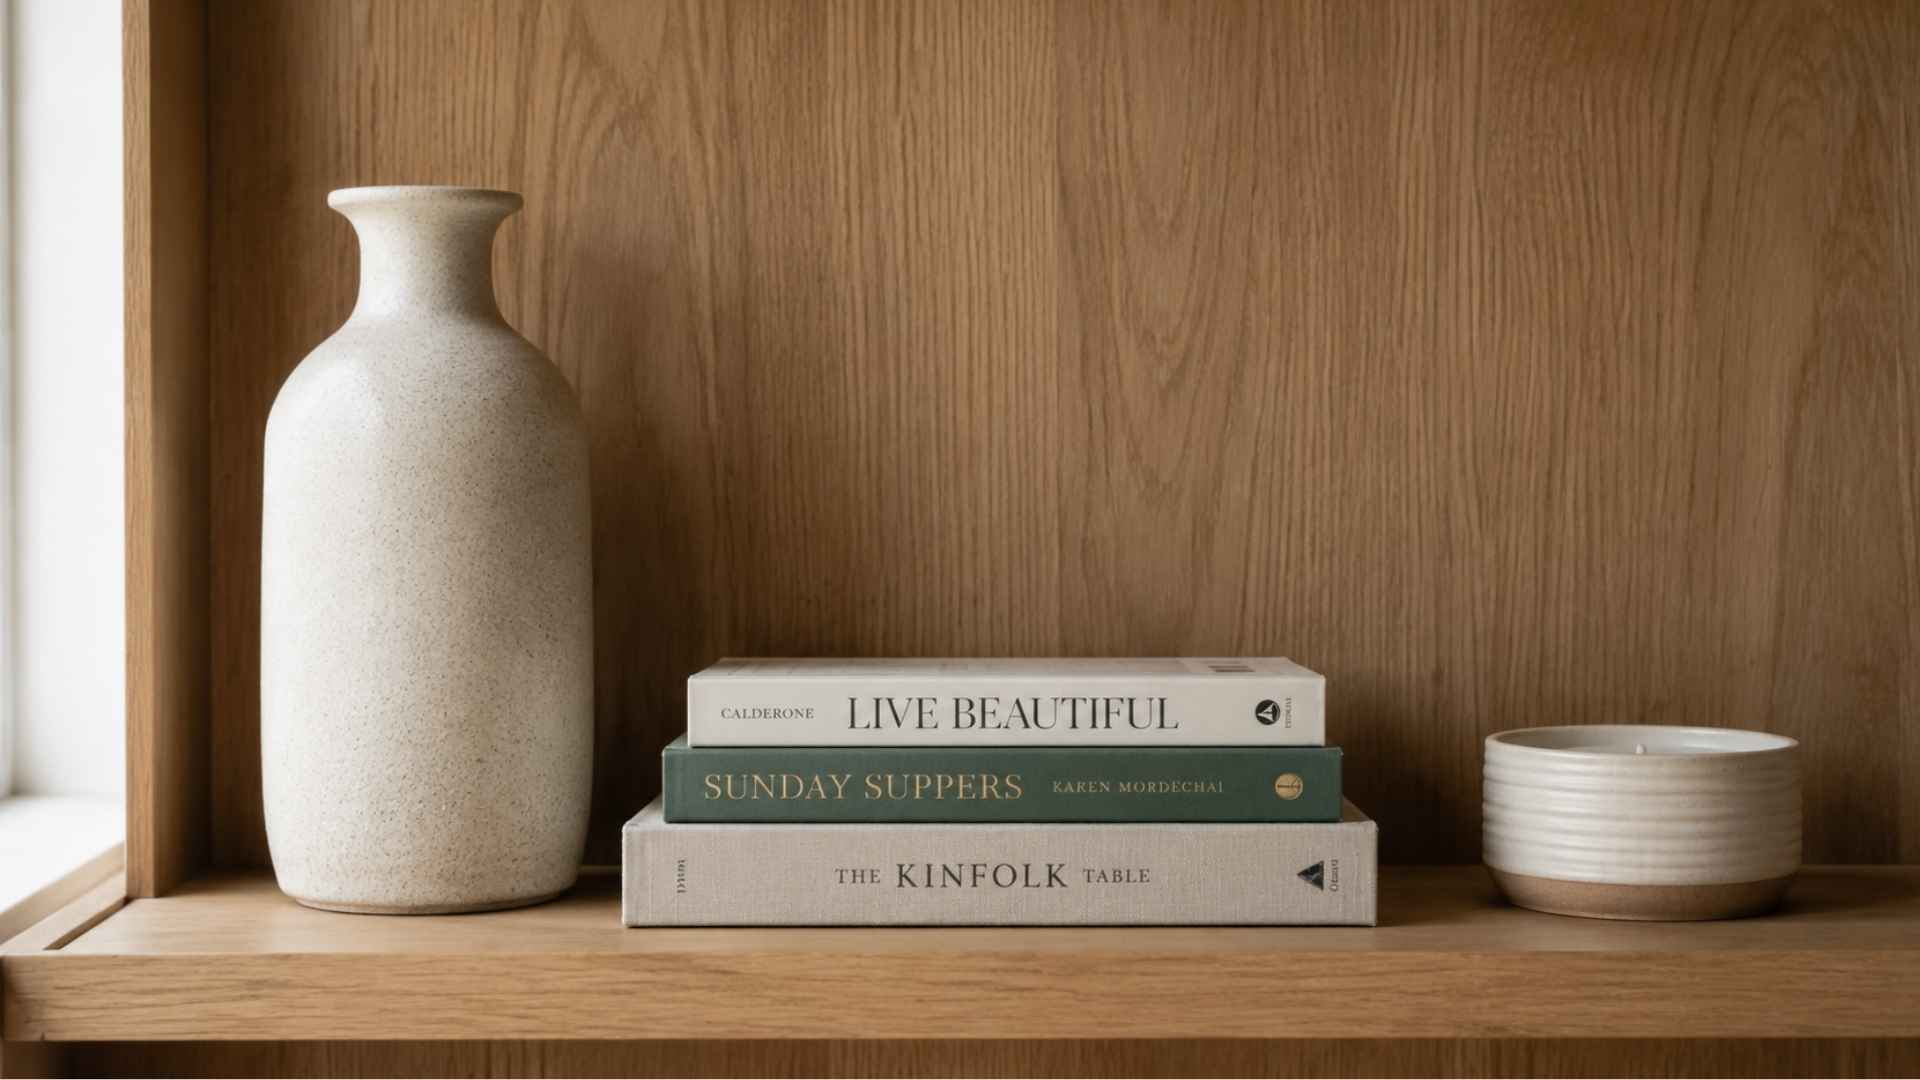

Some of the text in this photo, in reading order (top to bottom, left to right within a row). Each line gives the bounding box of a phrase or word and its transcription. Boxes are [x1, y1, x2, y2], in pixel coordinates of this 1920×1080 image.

[720, 706, 814, 720] CALDERONE
[848, 696, 1179, 730] LIVE BEAUTIFUL
[704, 773, 1023, 801] SUNDAY SUPPERS
[1053, 780, 1224, 794] KAREN MORDECHAI
[835, 863, 1151, 889] THE KINFOLK TABLE
